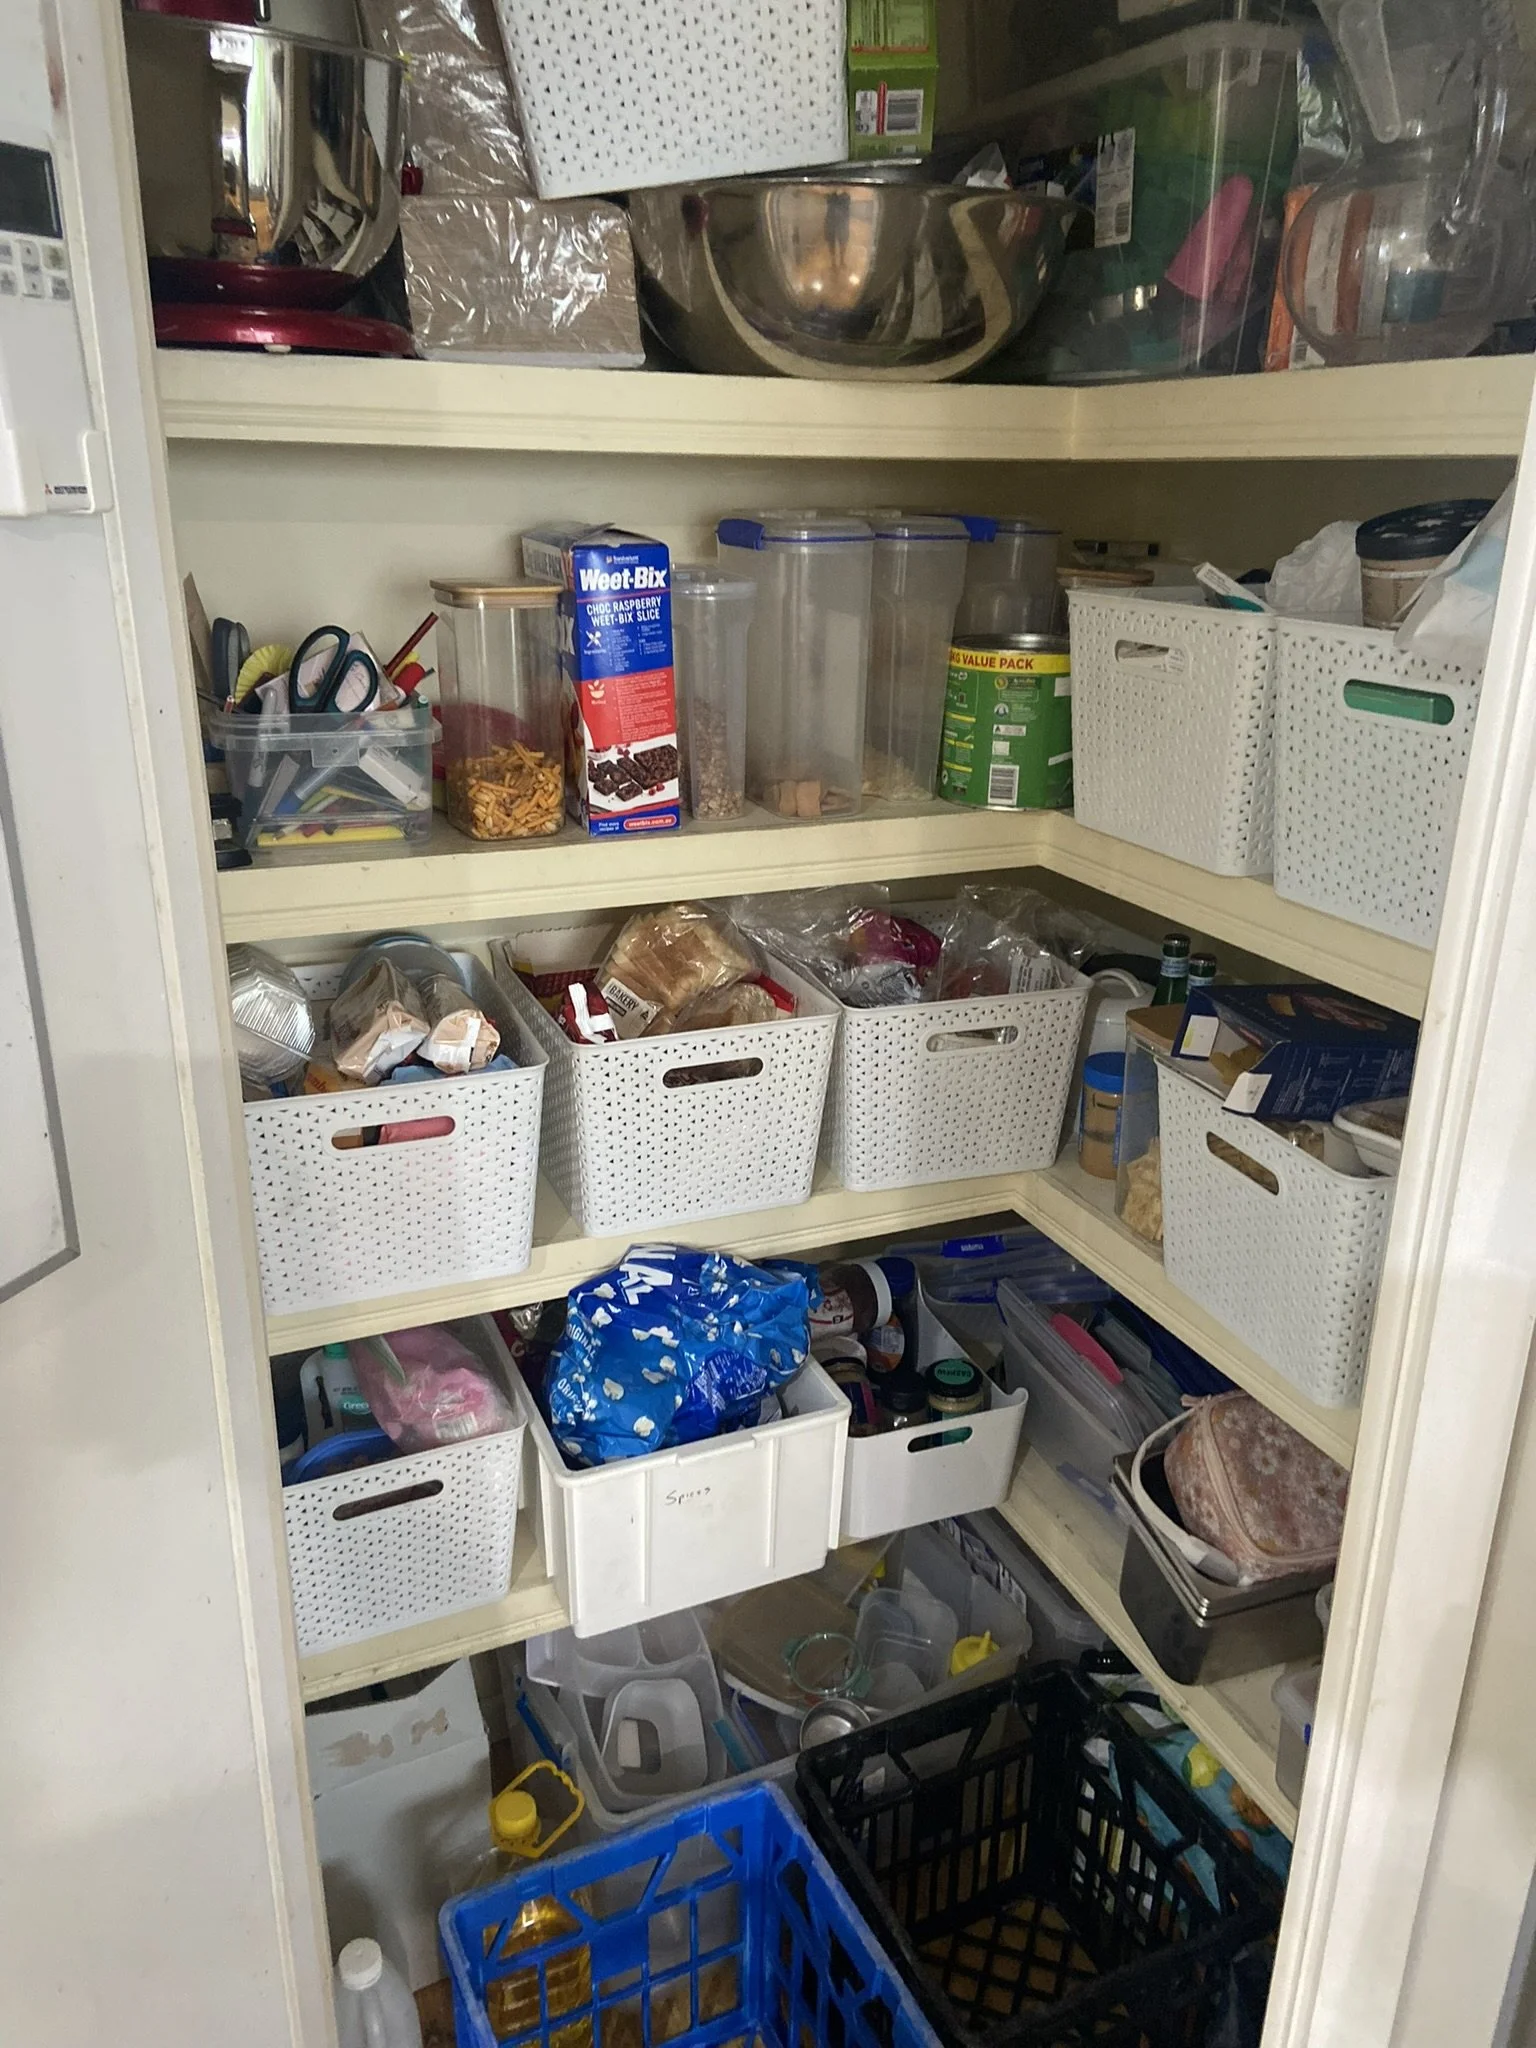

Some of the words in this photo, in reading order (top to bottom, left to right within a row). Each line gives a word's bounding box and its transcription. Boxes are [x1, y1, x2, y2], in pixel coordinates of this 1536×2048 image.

[579, 566, 667, 591] Weet-Bix
[586, 603, 611, 616] CHOC
[613, 596, 661, 614] RASPBERRY
[591, 611, 634, 627] WEET-BIX
[637, 608, 660, 622] SLICE
[962, 653, 996, 668] VALUE
[1000, 657, 1034, 670] PACK
[609, 984, 640, 1012] BAKERY
